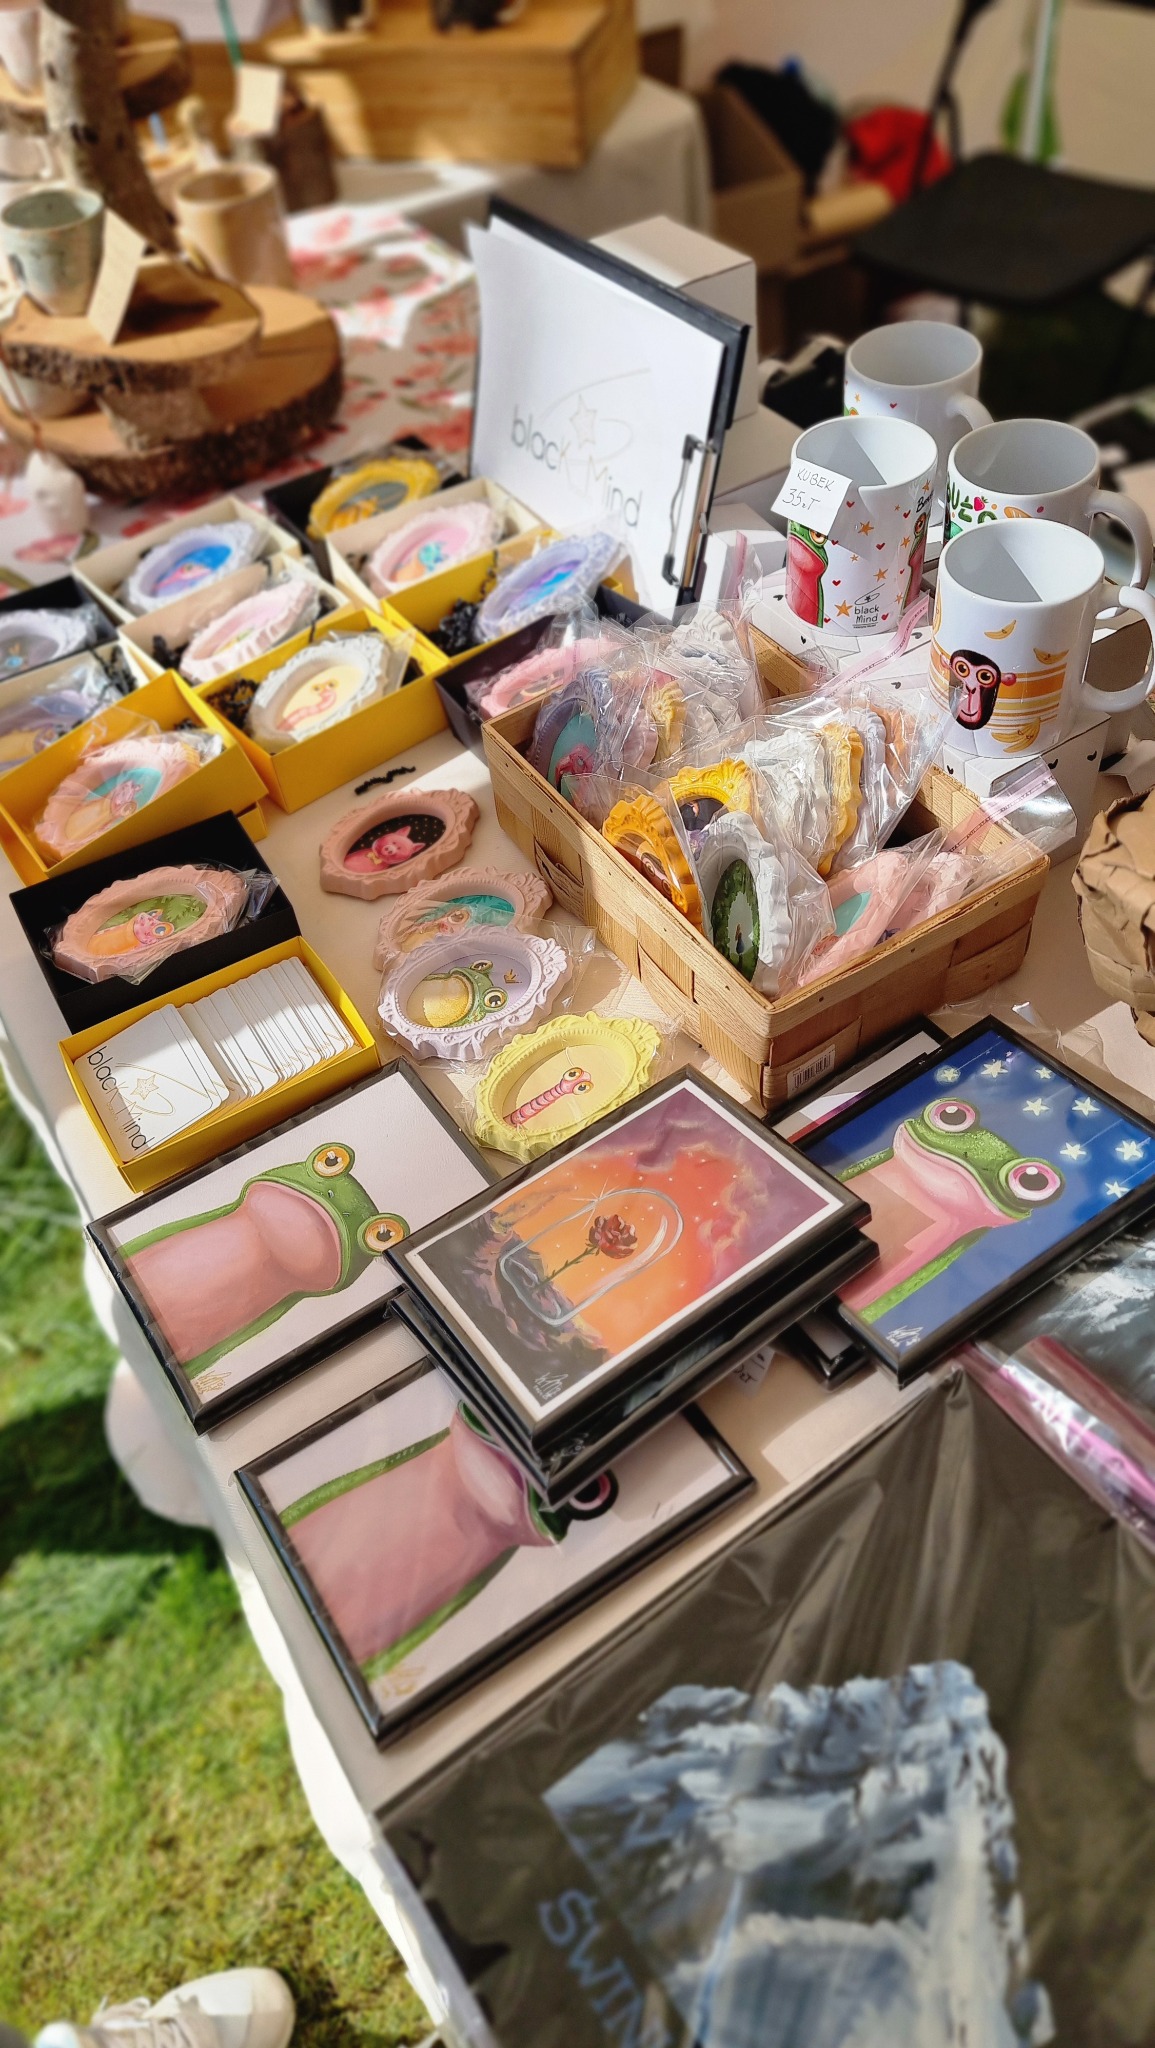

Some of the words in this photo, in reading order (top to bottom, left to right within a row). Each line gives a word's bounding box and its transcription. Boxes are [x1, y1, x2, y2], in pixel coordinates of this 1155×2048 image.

[797, 468, 835, 492] KUBEK
[854, 605, 880, 615] black
[856, 613, 879, 624] Mind
